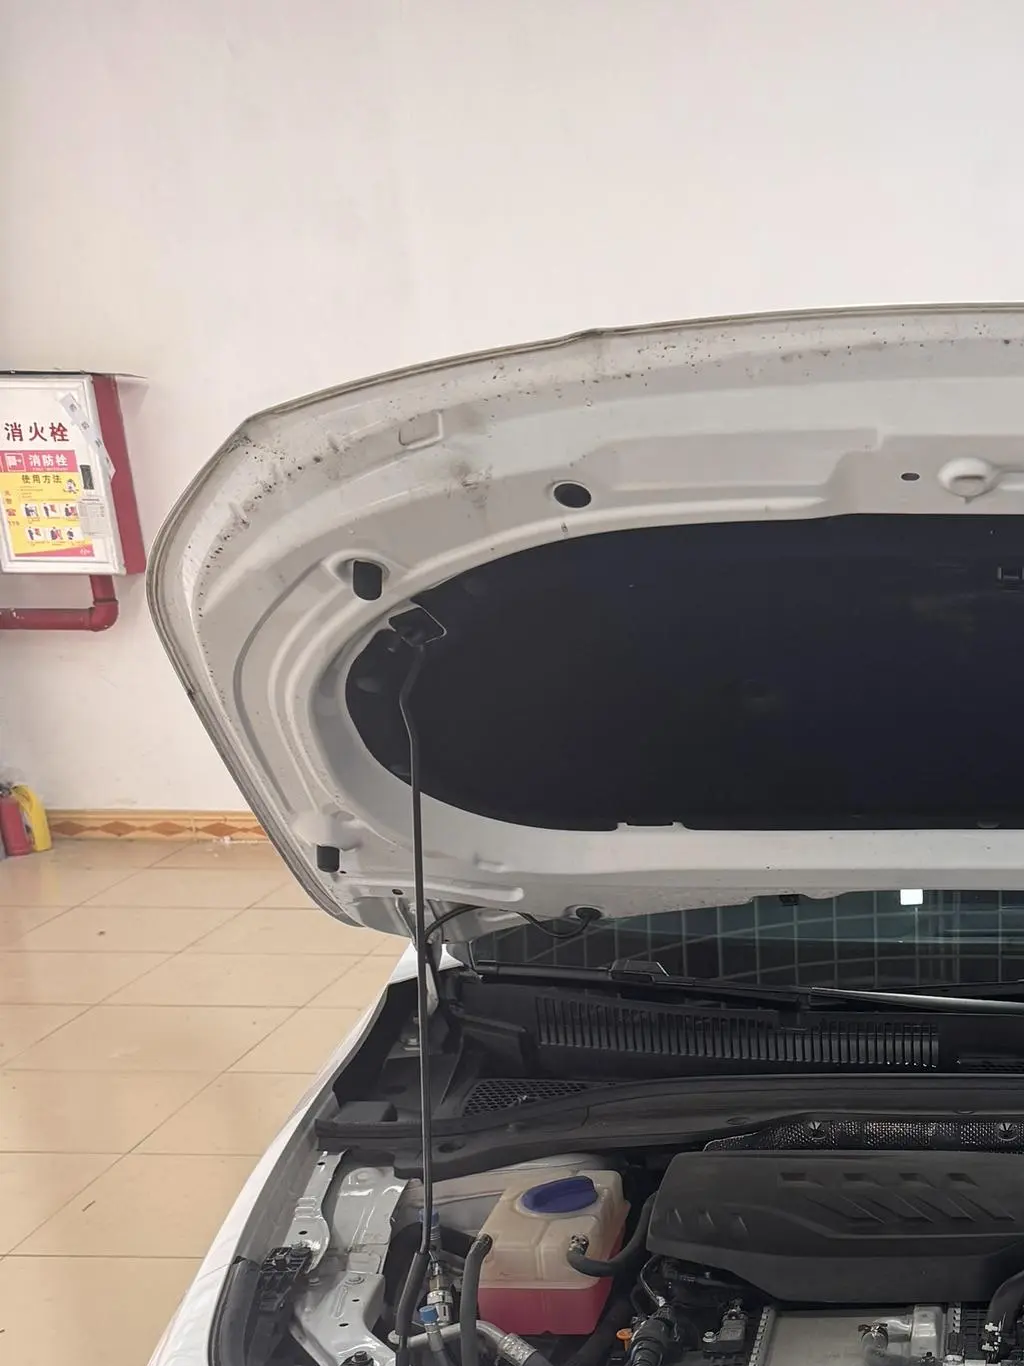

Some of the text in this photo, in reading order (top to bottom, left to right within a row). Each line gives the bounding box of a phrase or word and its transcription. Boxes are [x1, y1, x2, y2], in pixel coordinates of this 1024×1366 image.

[4, 422, 70, 442] 消火栓
[29, 454, 68, 467] 消防栓
[21, 474, 62, 484] 使用方法
